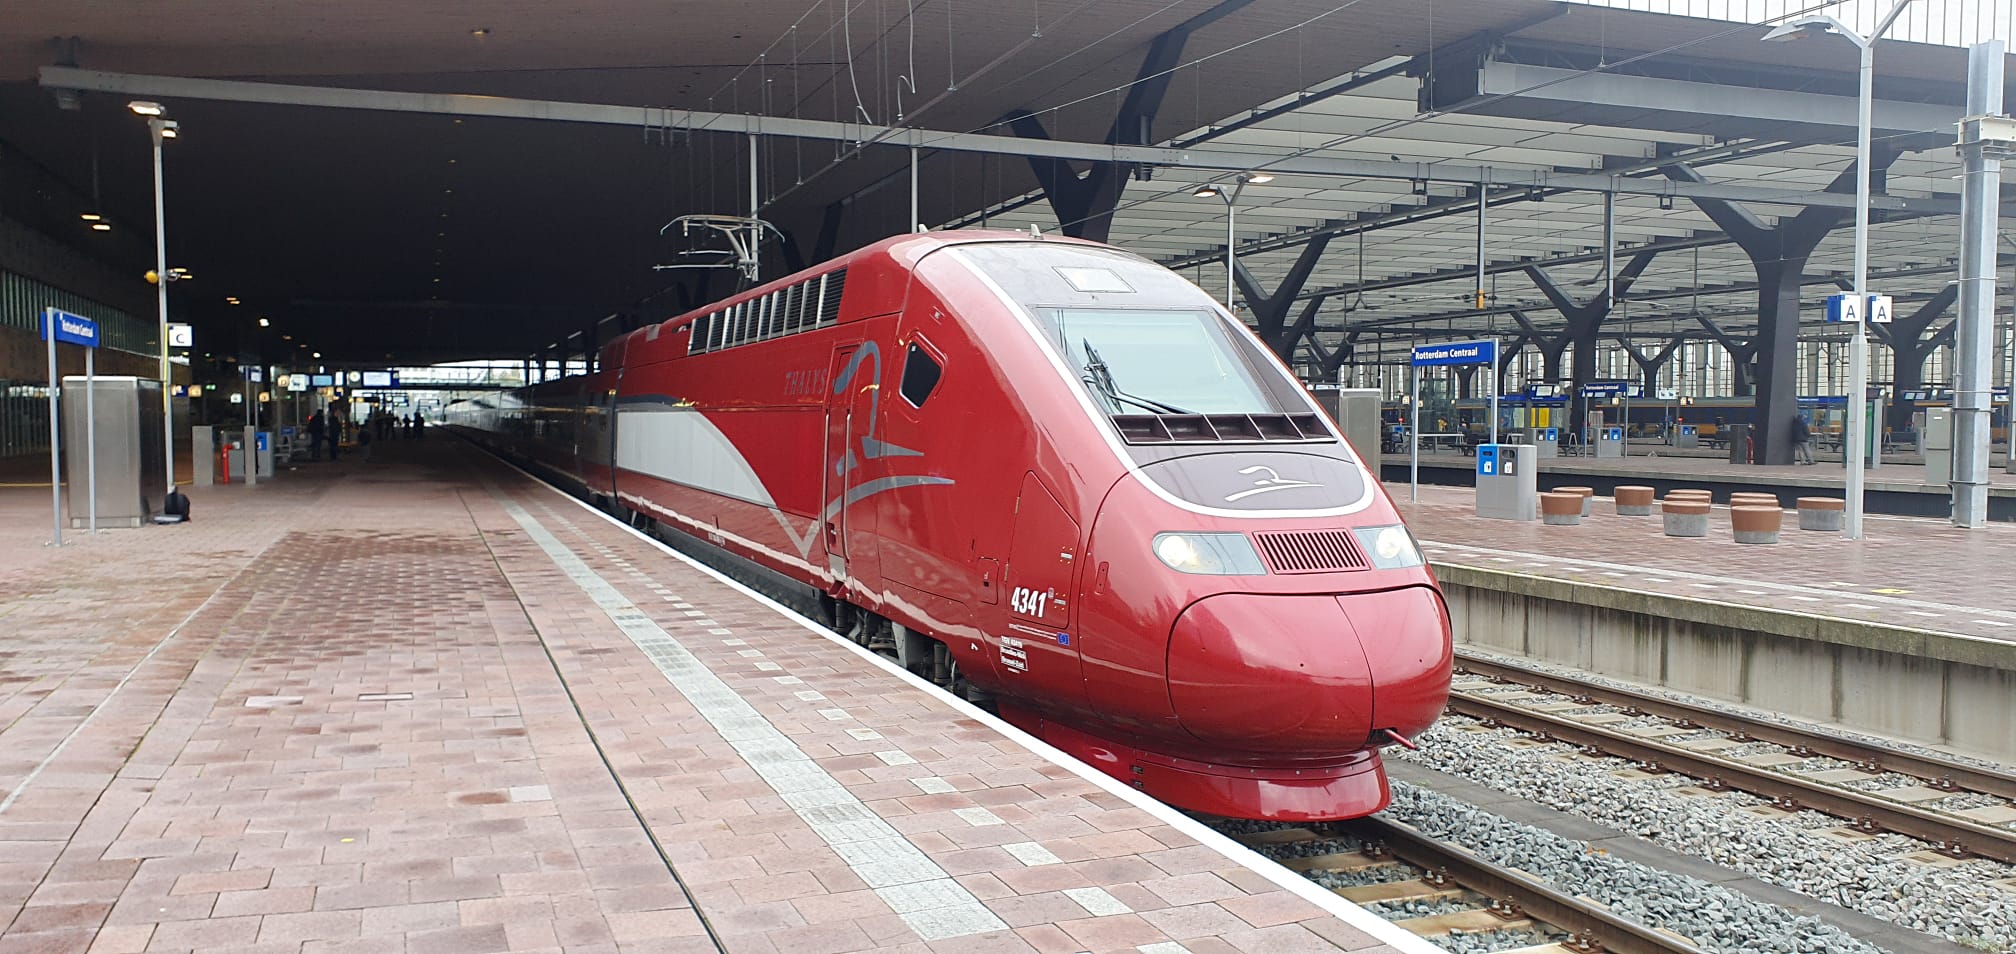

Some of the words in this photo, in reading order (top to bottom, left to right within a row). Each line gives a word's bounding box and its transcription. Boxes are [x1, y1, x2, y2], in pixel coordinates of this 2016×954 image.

[1846, 304, 1856, 319] A
[1877, 305, 1887, 320] A
[175, 333, 185, 344] C
[1415, 349, 1448, 360] Rotterdam
[1449, 346, 1478, 358] Centraal
[784, 367, 828, 396] THALYS
[1011, 586, 1047, 618] 4341
